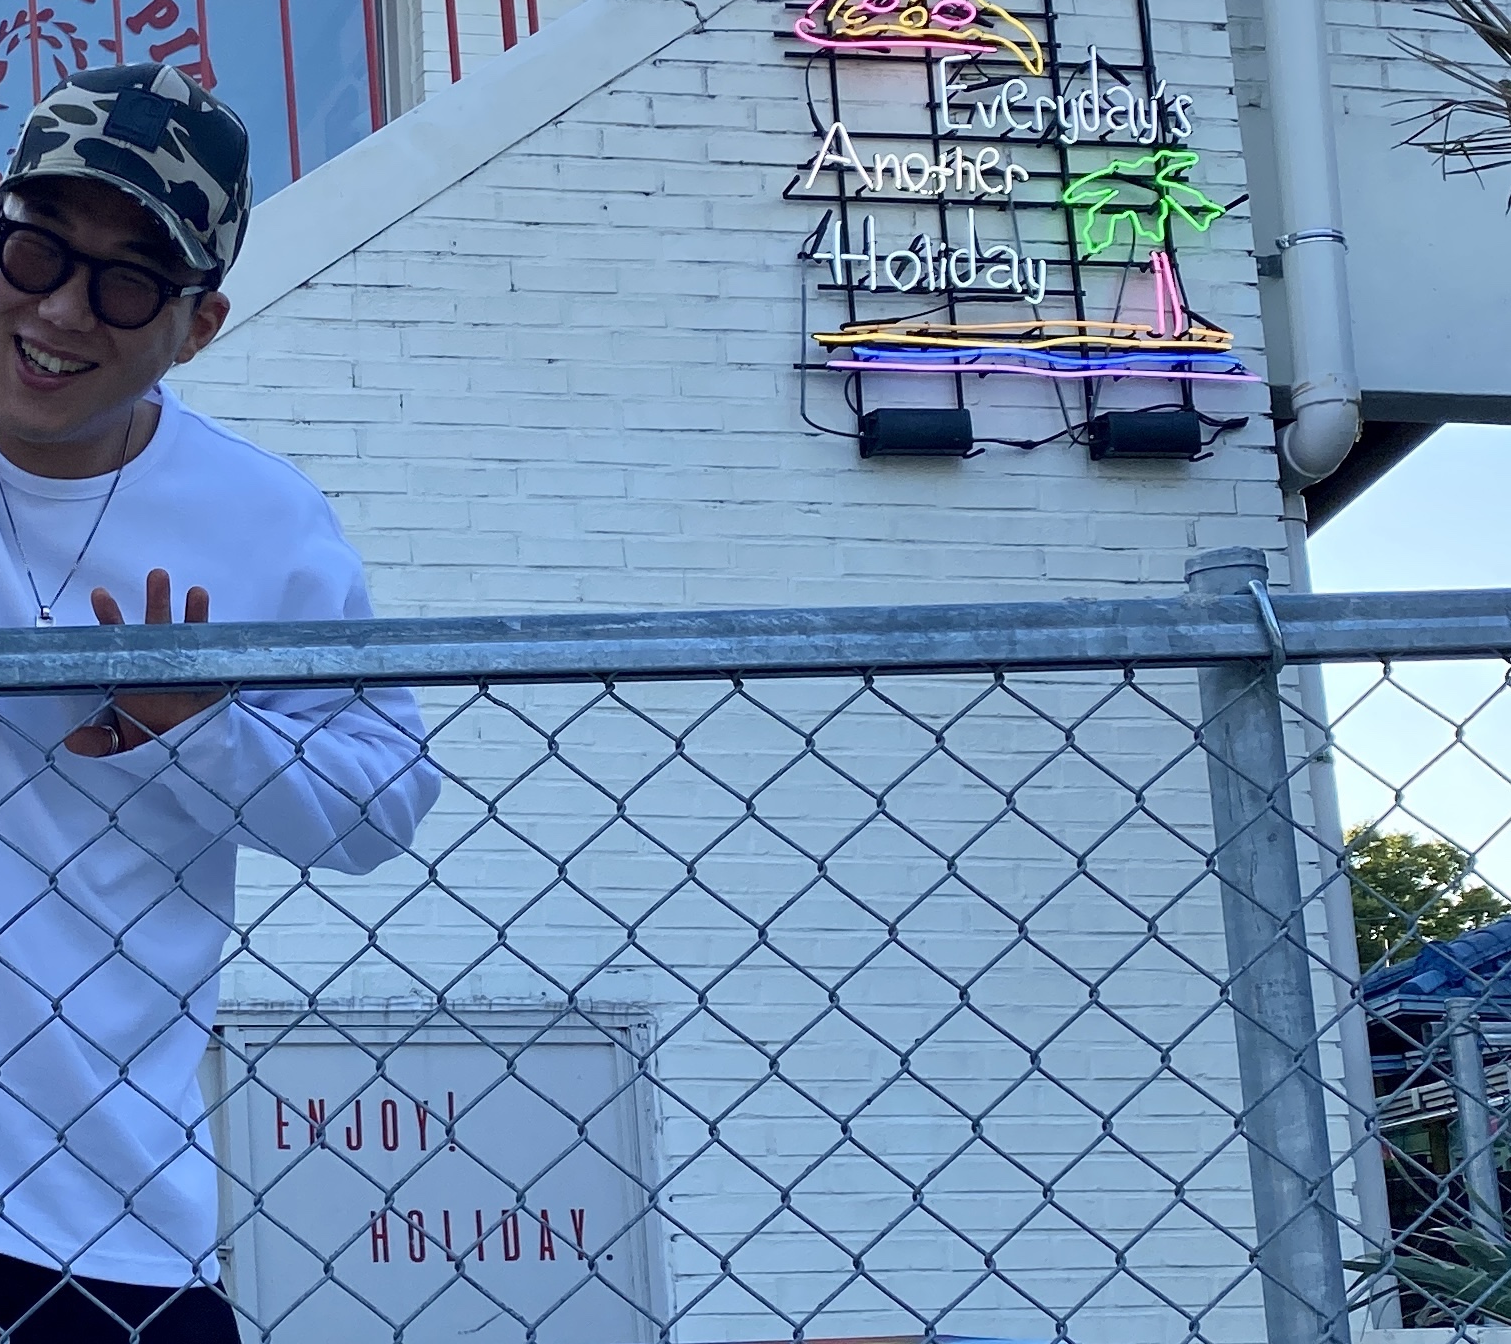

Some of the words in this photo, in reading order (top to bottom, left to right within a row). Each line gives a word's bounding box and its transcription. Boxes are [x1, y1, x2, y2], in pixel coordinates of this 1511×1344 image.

[938, 45, 1194, 144] Everyday's
[805, 121, 1029, 195] Another
[812, 207, 1047, 304] Holiday
[276, 1091, 457, 1152] ENJOY!
